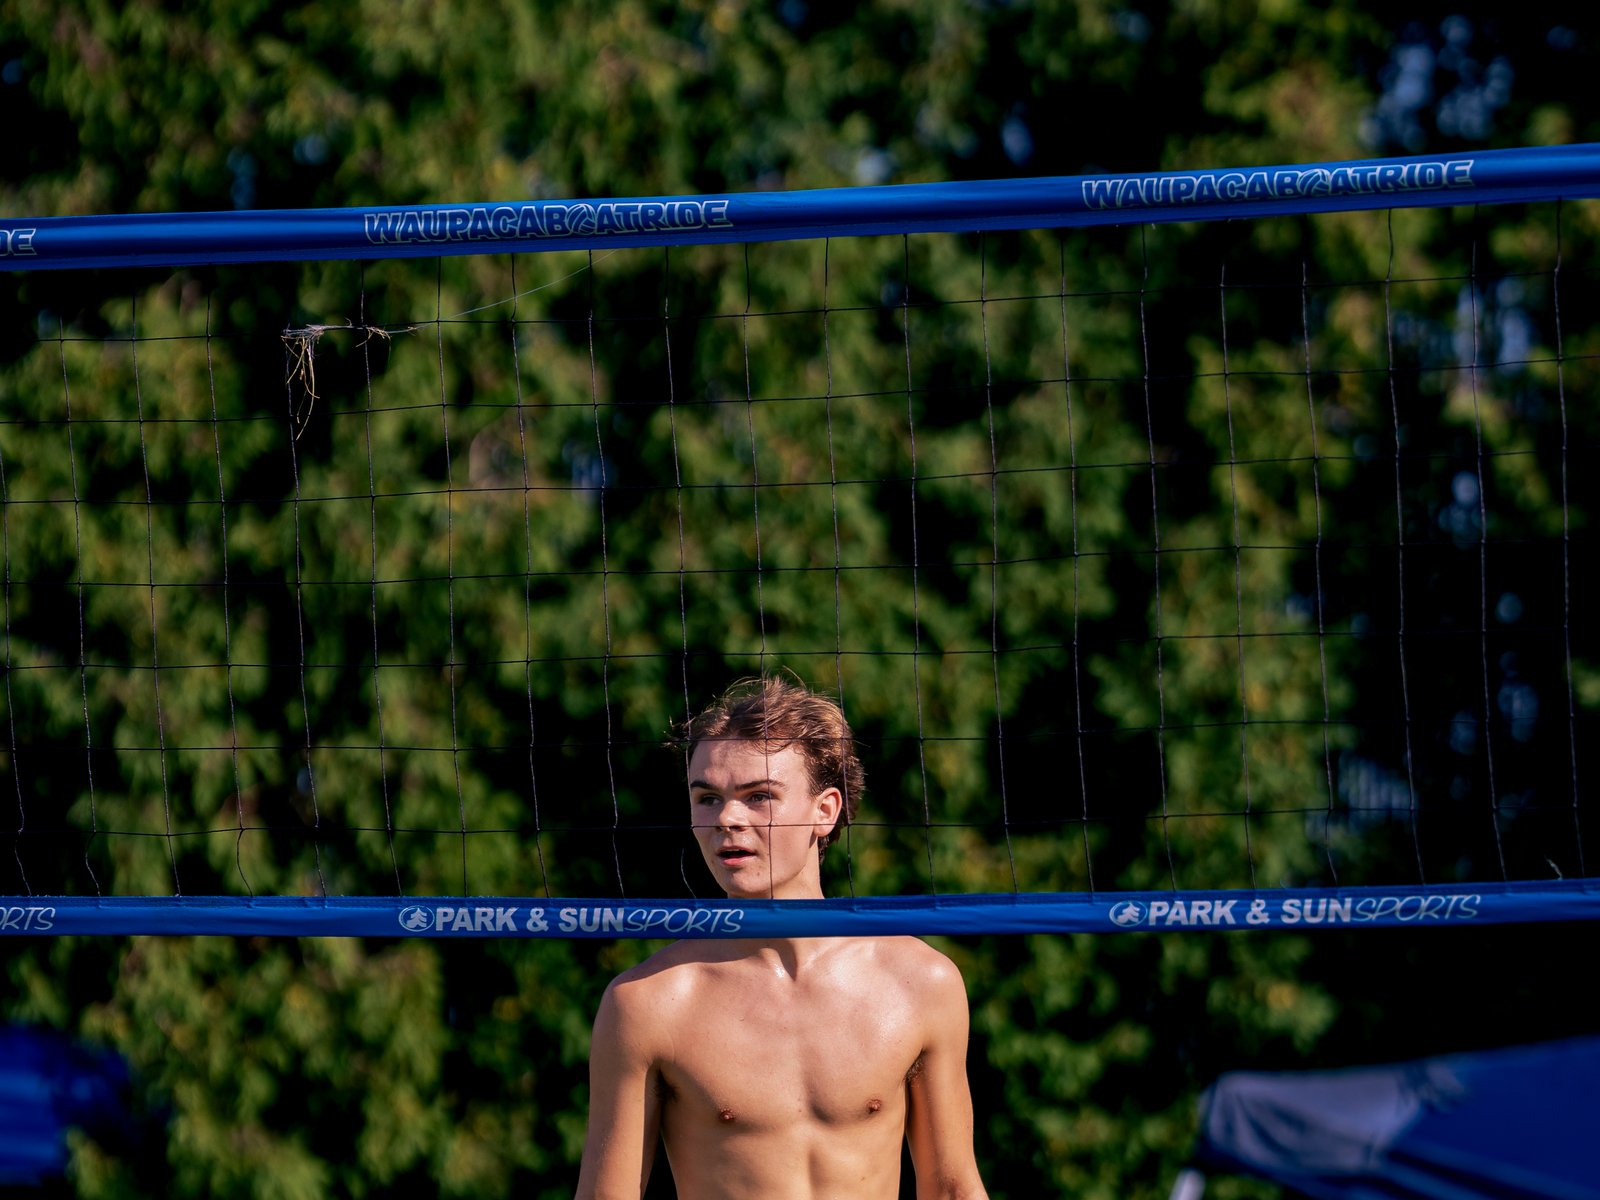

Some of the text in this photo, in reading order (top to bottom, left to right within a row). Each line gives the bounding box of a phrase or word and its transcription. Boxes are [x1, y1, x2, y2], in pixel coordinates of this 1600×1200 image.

[0, 906, 56, 931] RTS
[436, 907, 519, 932] PARK
[525, 907, 550, 932] &
[1149, 900, 1237, 926] PARK
[1246, 898, 1271, 925] &
